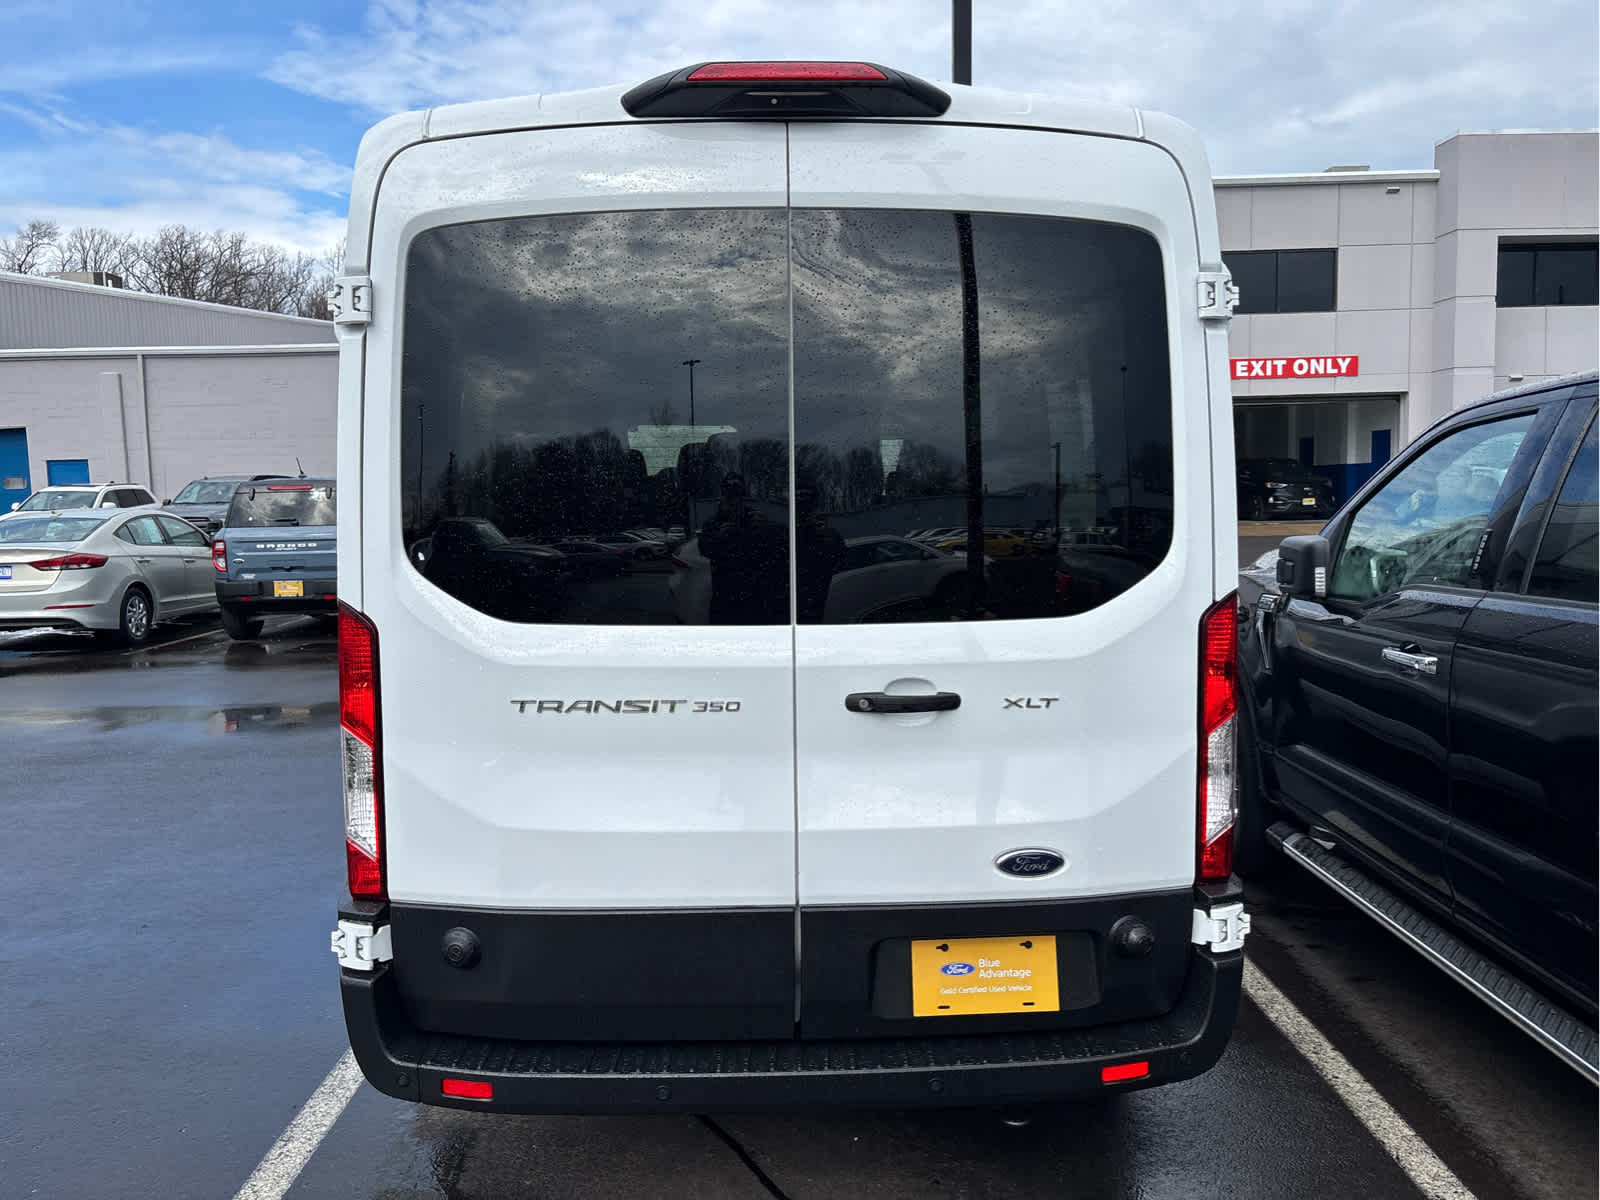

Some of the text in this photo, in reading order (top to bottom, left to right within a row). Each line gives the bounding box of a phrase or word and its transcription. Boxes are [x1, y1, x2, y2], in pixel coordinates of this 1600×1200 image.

[1235, 358, 1352, 376] EXIT ONLY
[510, 700, 741, 714] TRANSIT 350
[1003, 698, 1060, 709] XLT
[978, 958, 1000, 968] Blue
[978, 968, 1032, 979] Advantage
[958, 986, 988, 994] Certified
